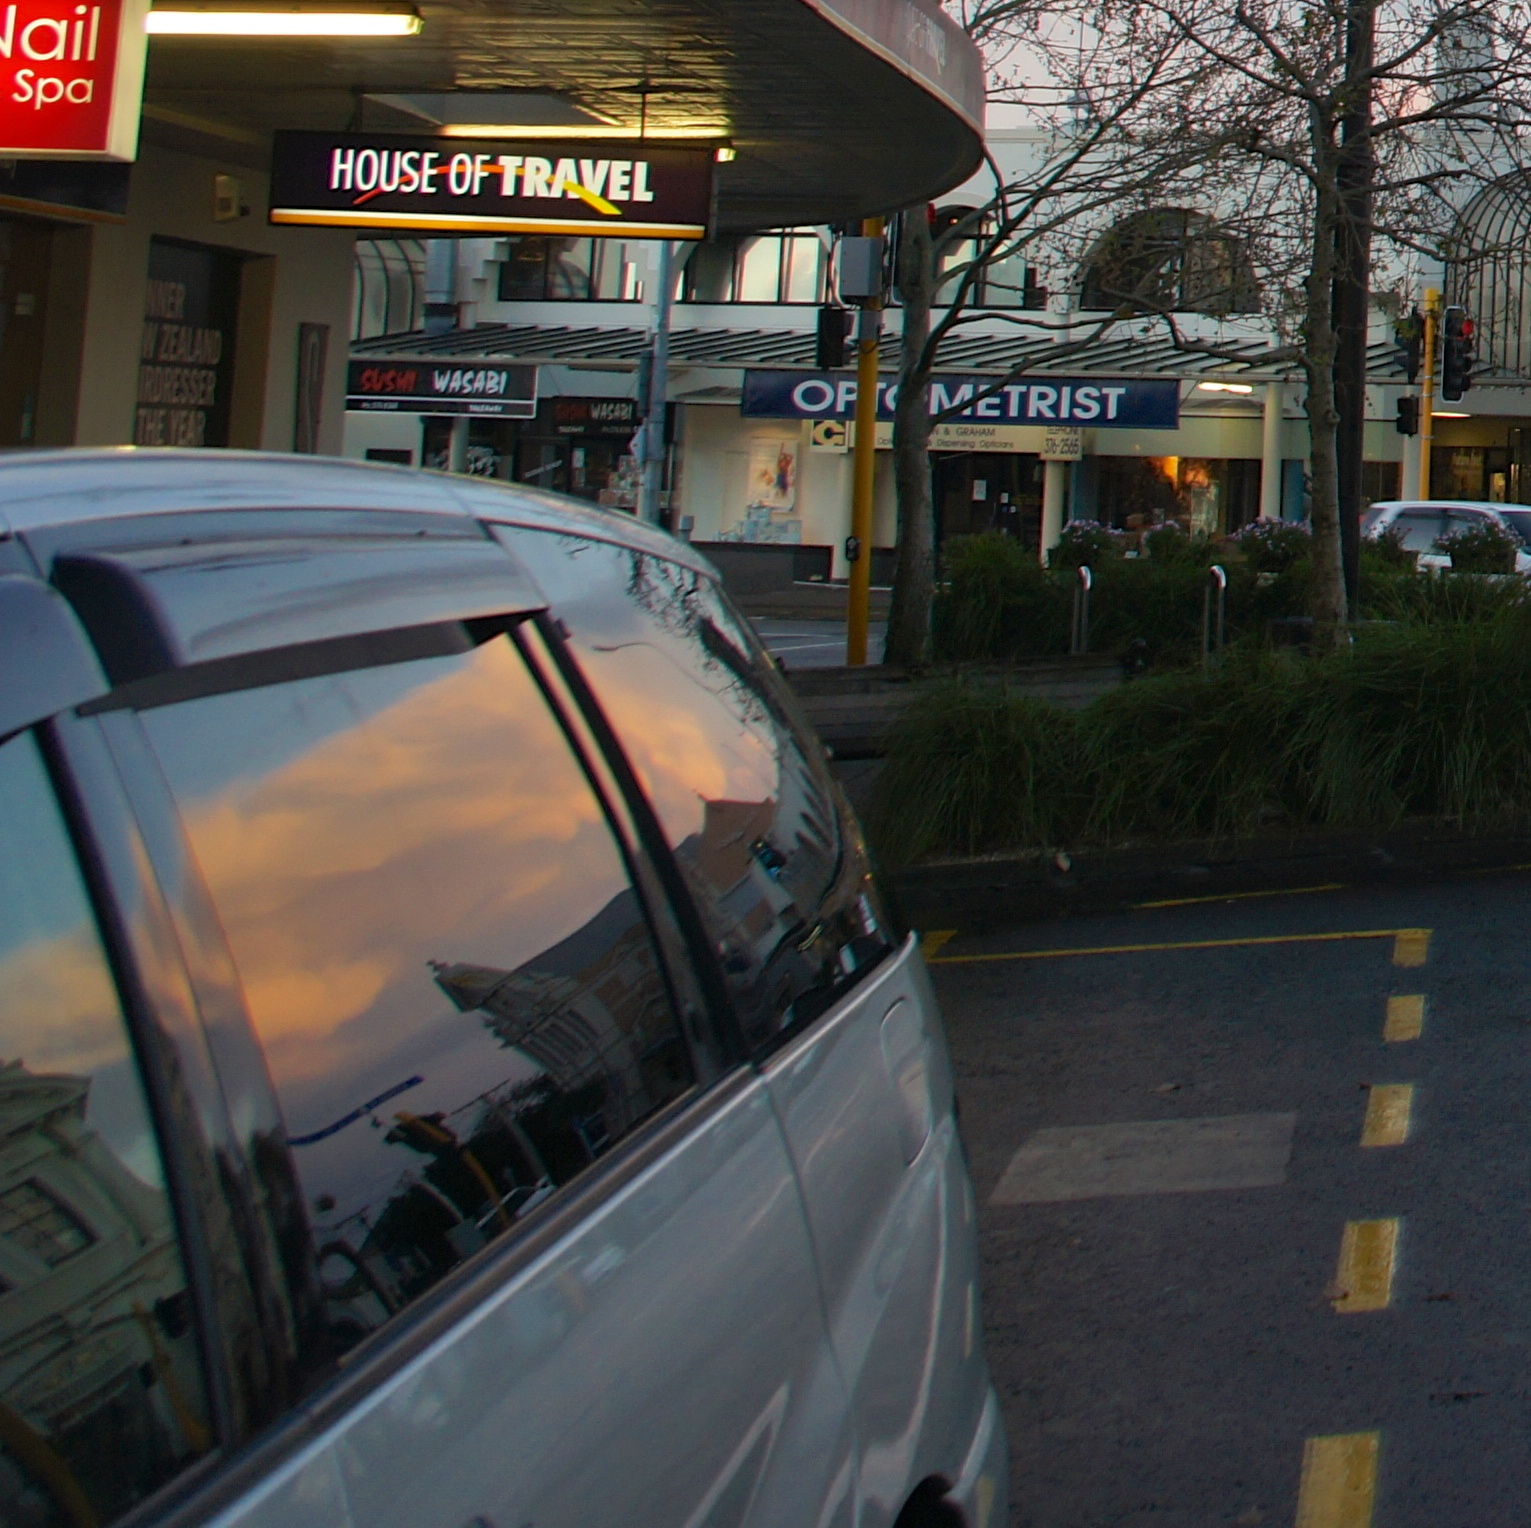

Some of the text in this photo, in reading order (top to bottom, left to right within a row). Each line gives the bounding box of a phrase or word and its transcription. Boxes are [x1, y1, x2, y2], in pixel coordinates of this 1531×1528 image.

[12, 68, 94, 110] Spa
[330, 148, 654, 202] HOUSE OF TRAVEL
[361, 368, 508, 395] SUSHI WASABI
[794, 378, 1127, 420] OPMETRIST
[955, 427, 996, 437] GRAHAM
